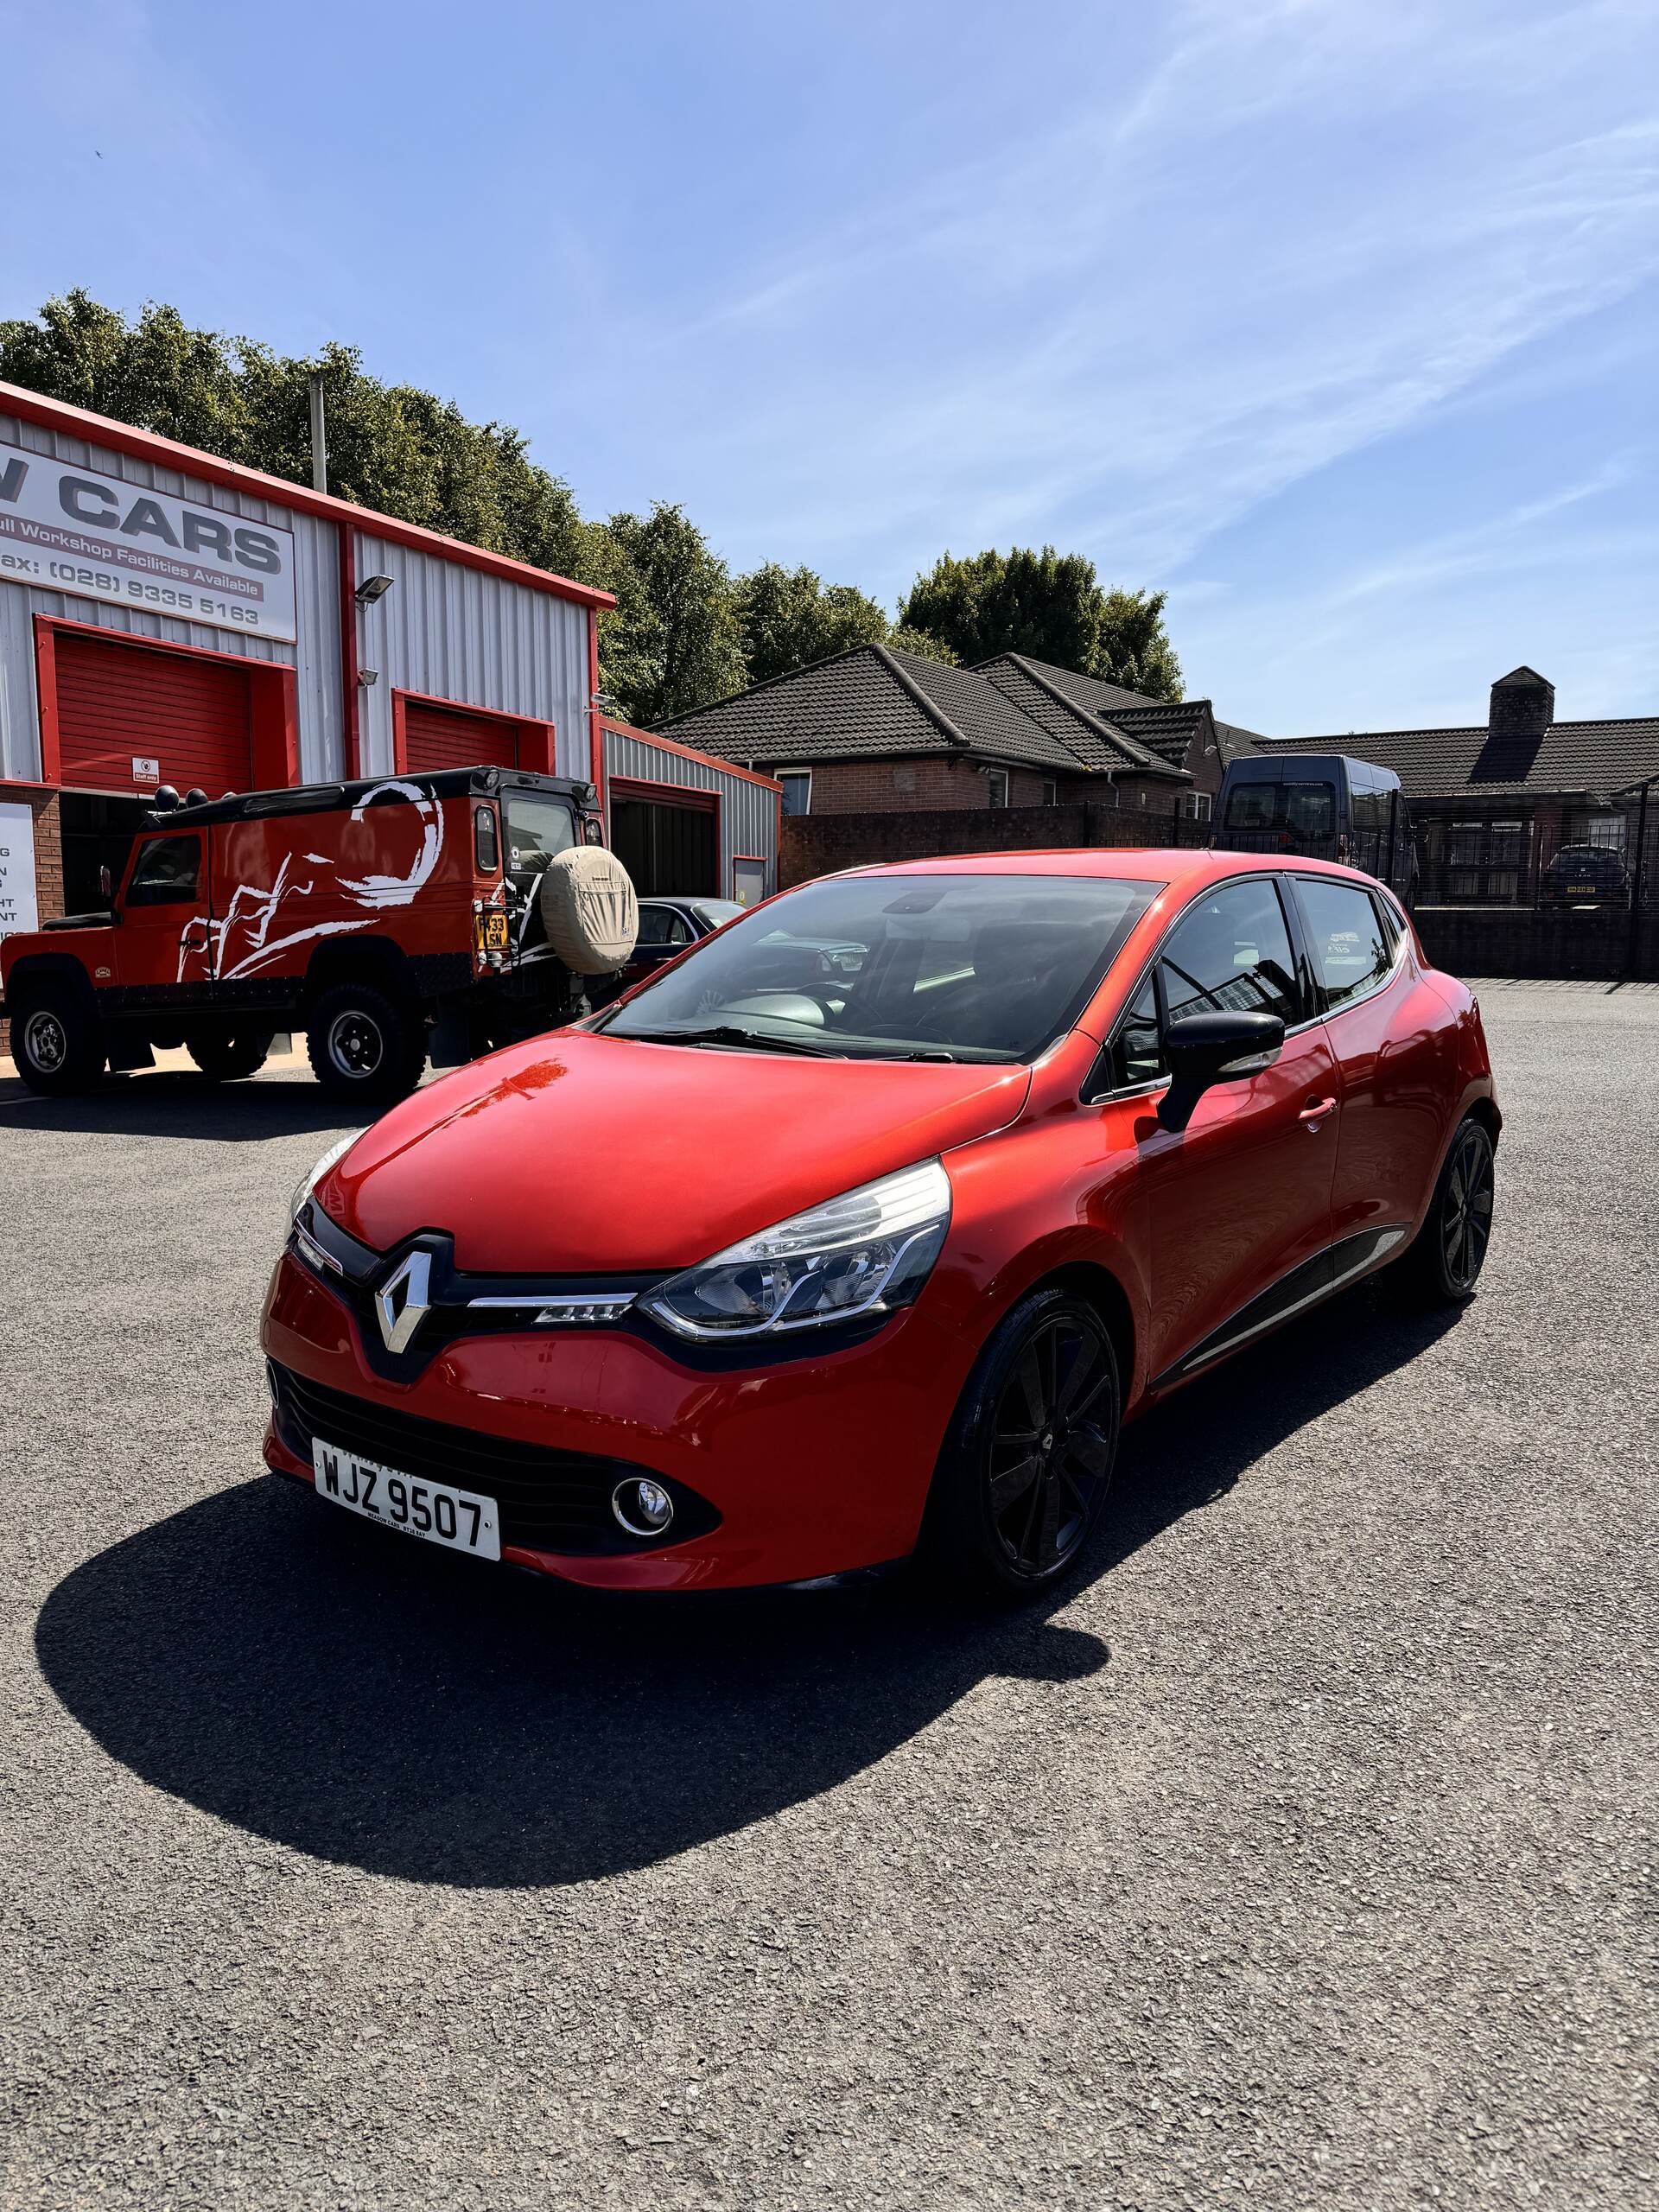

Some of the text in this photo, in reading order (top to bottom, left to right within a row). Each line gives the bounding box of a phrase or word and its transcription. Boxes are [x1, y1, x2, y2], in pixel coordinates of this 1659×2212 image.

[21, 522, 112, 562] Workshop
[118, 548, 188, 579] Facilities
[194, 568, 257, 595] Available
[59, 475, 282, 575] CARS
[49, 562, 120, 591] (028)
[128, 581, 193, 608] 9335
[200, 598, 258, 625] 5163
[322, 1450, 380, 1515] WJZ
[388, 1478, 481, 1548] 9507
